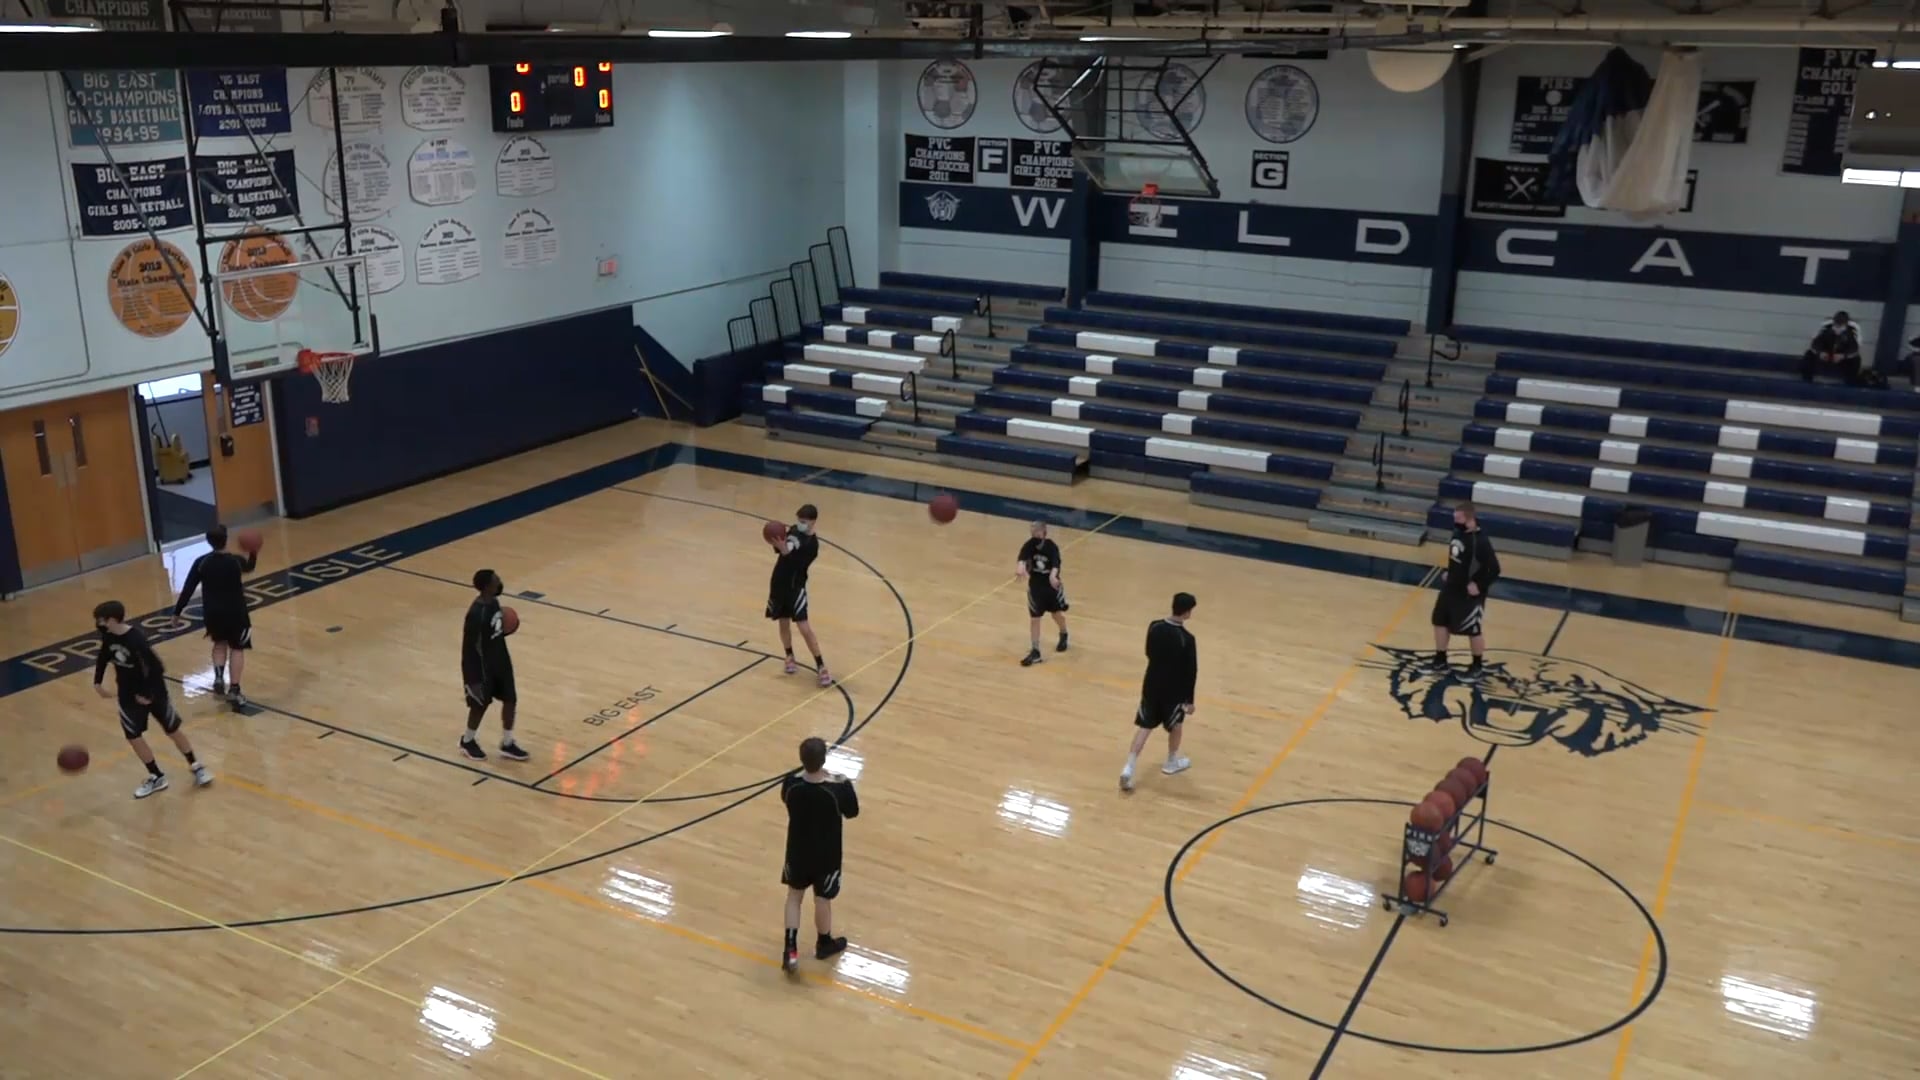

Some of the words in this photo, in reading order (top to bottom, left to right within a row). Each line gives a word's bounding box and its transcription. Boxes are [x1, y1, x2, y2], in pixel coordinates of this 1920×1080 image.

[64, 0, 149, 16] CHAMPIONS
[1824, 49, 1869, 69] PVC
[84, 72, 110, 88] BIG
[118, 71, 157, 88] EAST
[1800, 66, 1857, 81] CHAMPI
[1820, 82, 1856, 95] GOL
[66, 88, 177, 107] CO-CHAMPIONS
[110, 107, 179, 125] BASKETBALL
[928, 136, 951, 150] PVC
[1033, 141, 1061, 155] PVC
[915, 147, 966, 162] CHAMPIONS
[982, 147, 1004, 171] F
[1019, 154, 1075, 168] CHAMPIONS
[217, 160, 239, 175] BIG
[908, 157, 935, 170] GIRLS
[936, 160, 971, 173] SOCCER
[1014, 164, 1042, 178] GIRLS
[1043, 167, 1074, 179] SOCCE
[96, 167, 121, 184] BIG
[129, 163, 166, 182] EAST
[928, 171, 951, 182] 2011
[1255, 162, 1285, 187] G
[1034, 178, 1058, 189] 2012
[106, 185, 162, 201] CHAPIONS
[87, 204, 119, 217] GIRLS
[122, 197, 184, 215] BAKETBALL
[113, 215, 167, 231] 2005-006
[21, 578, 301, 675] PRSE
[289, 544, 404, 584] ISLE
[583, 708, 621, 727] BIG
[613, 684, 663, 710] EAST
